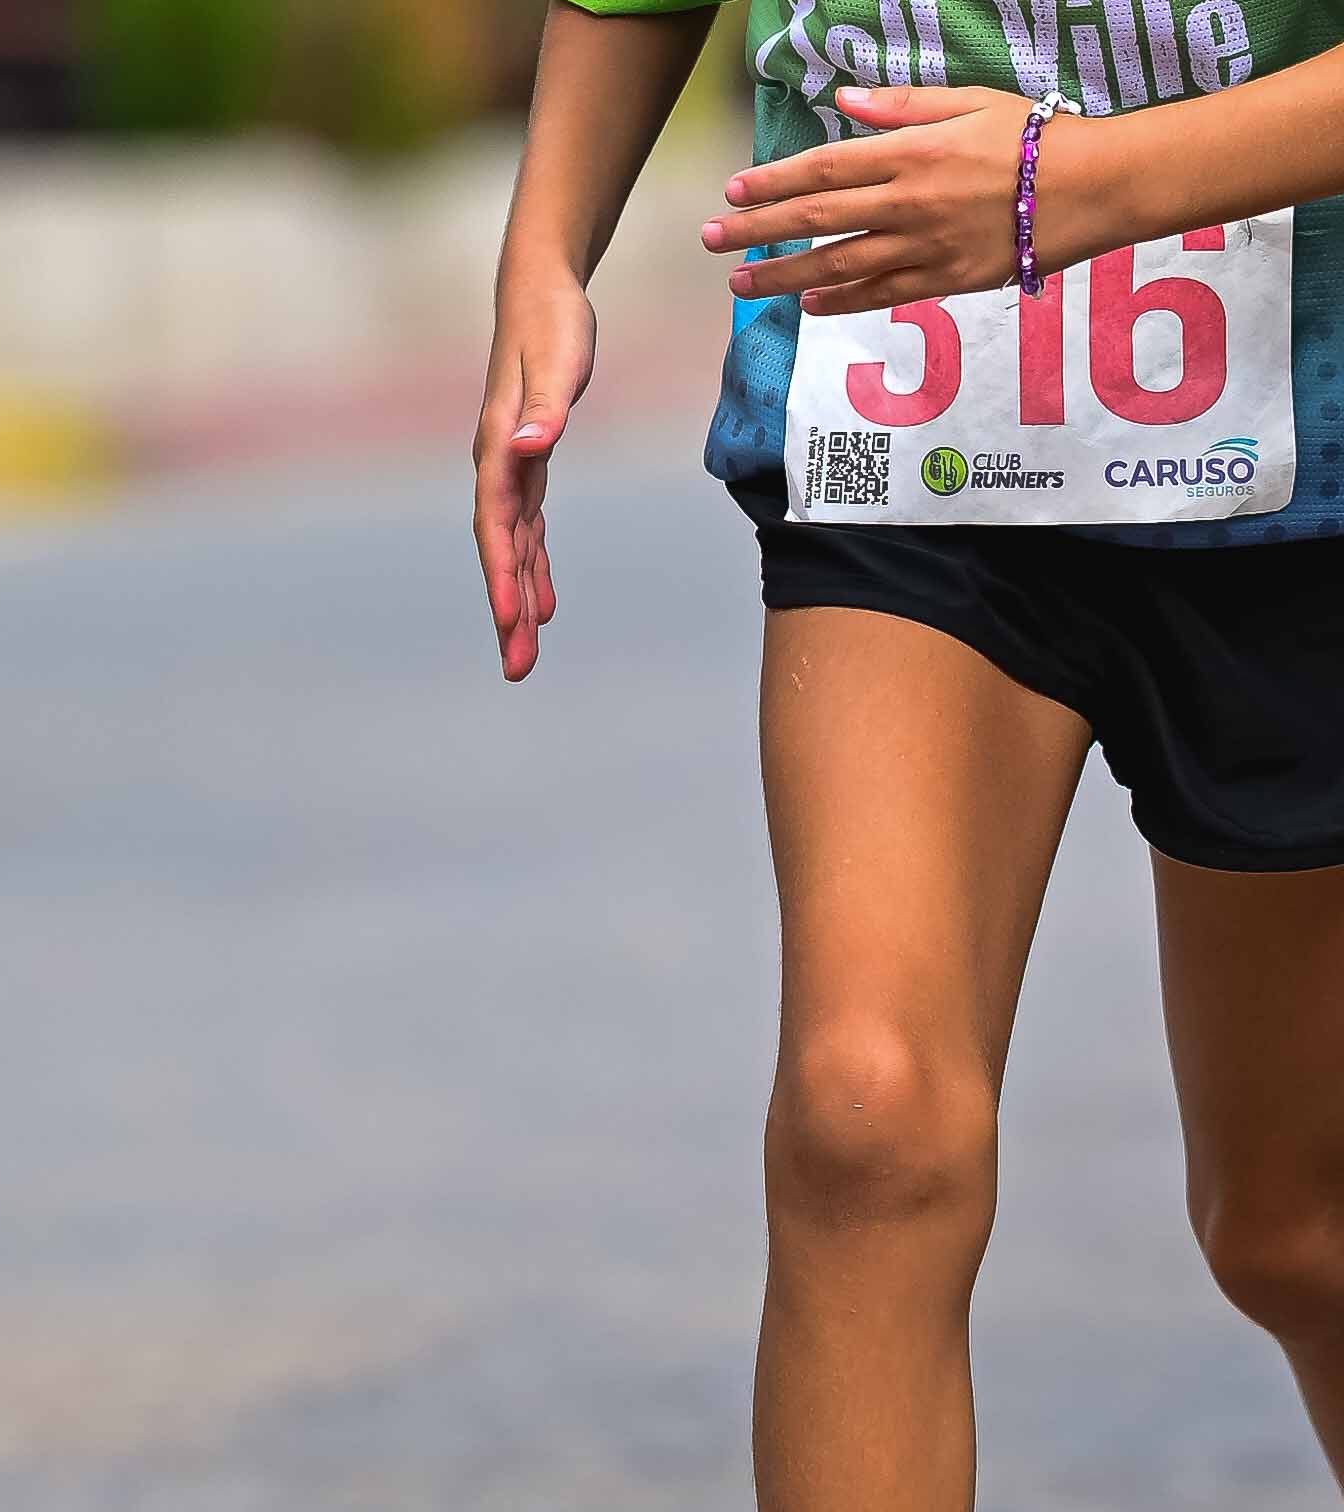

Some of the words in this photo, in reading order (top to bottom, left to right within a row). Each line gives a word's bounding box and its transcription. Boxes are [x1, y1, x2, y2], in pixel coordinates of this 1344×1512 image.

[973, 453, 1022, 471] CLUB
[970, 471, 1065, 489] RUNNER'S
[1105, 457, 1255, 487] CARUSO
[1186, 486, 1255, 497] SEGUROS
